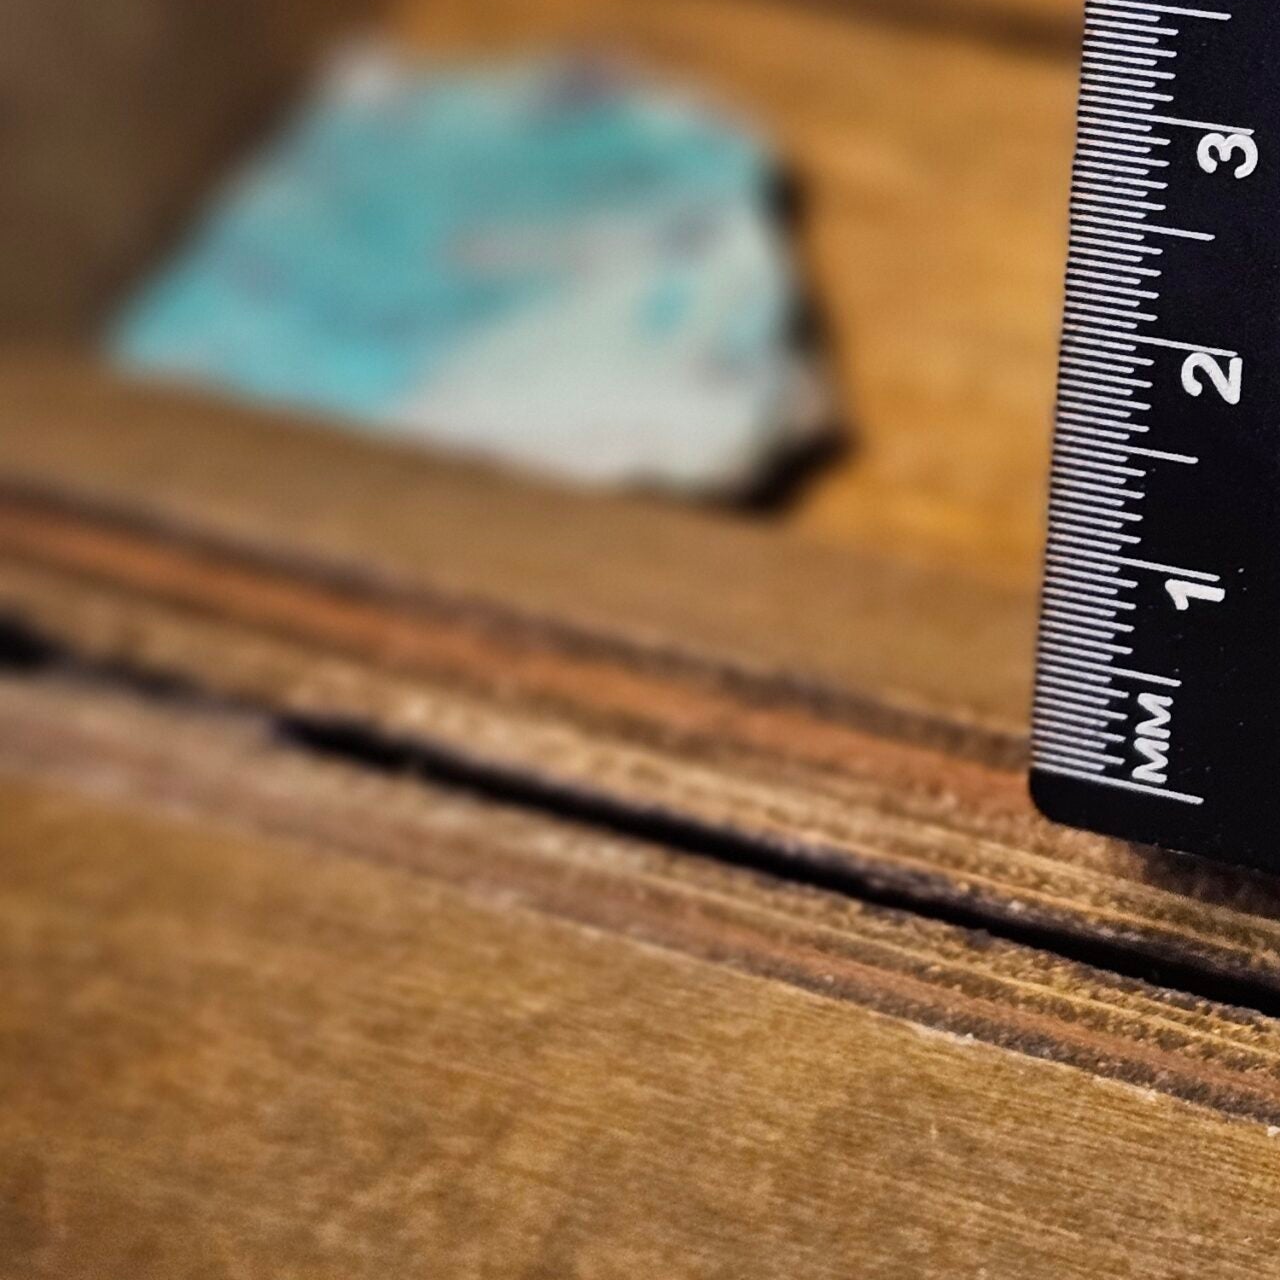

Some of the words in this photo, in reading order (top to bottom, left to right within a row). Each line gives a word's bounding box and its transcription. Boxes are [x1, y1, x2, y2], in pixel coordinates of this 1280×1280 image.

[1197, 132, 1258, 180] 3
[1181, 352, 1242, 405] 2
[1165, 579, 1226, 611] 1
[1132, 693, 1173, 785] MM
